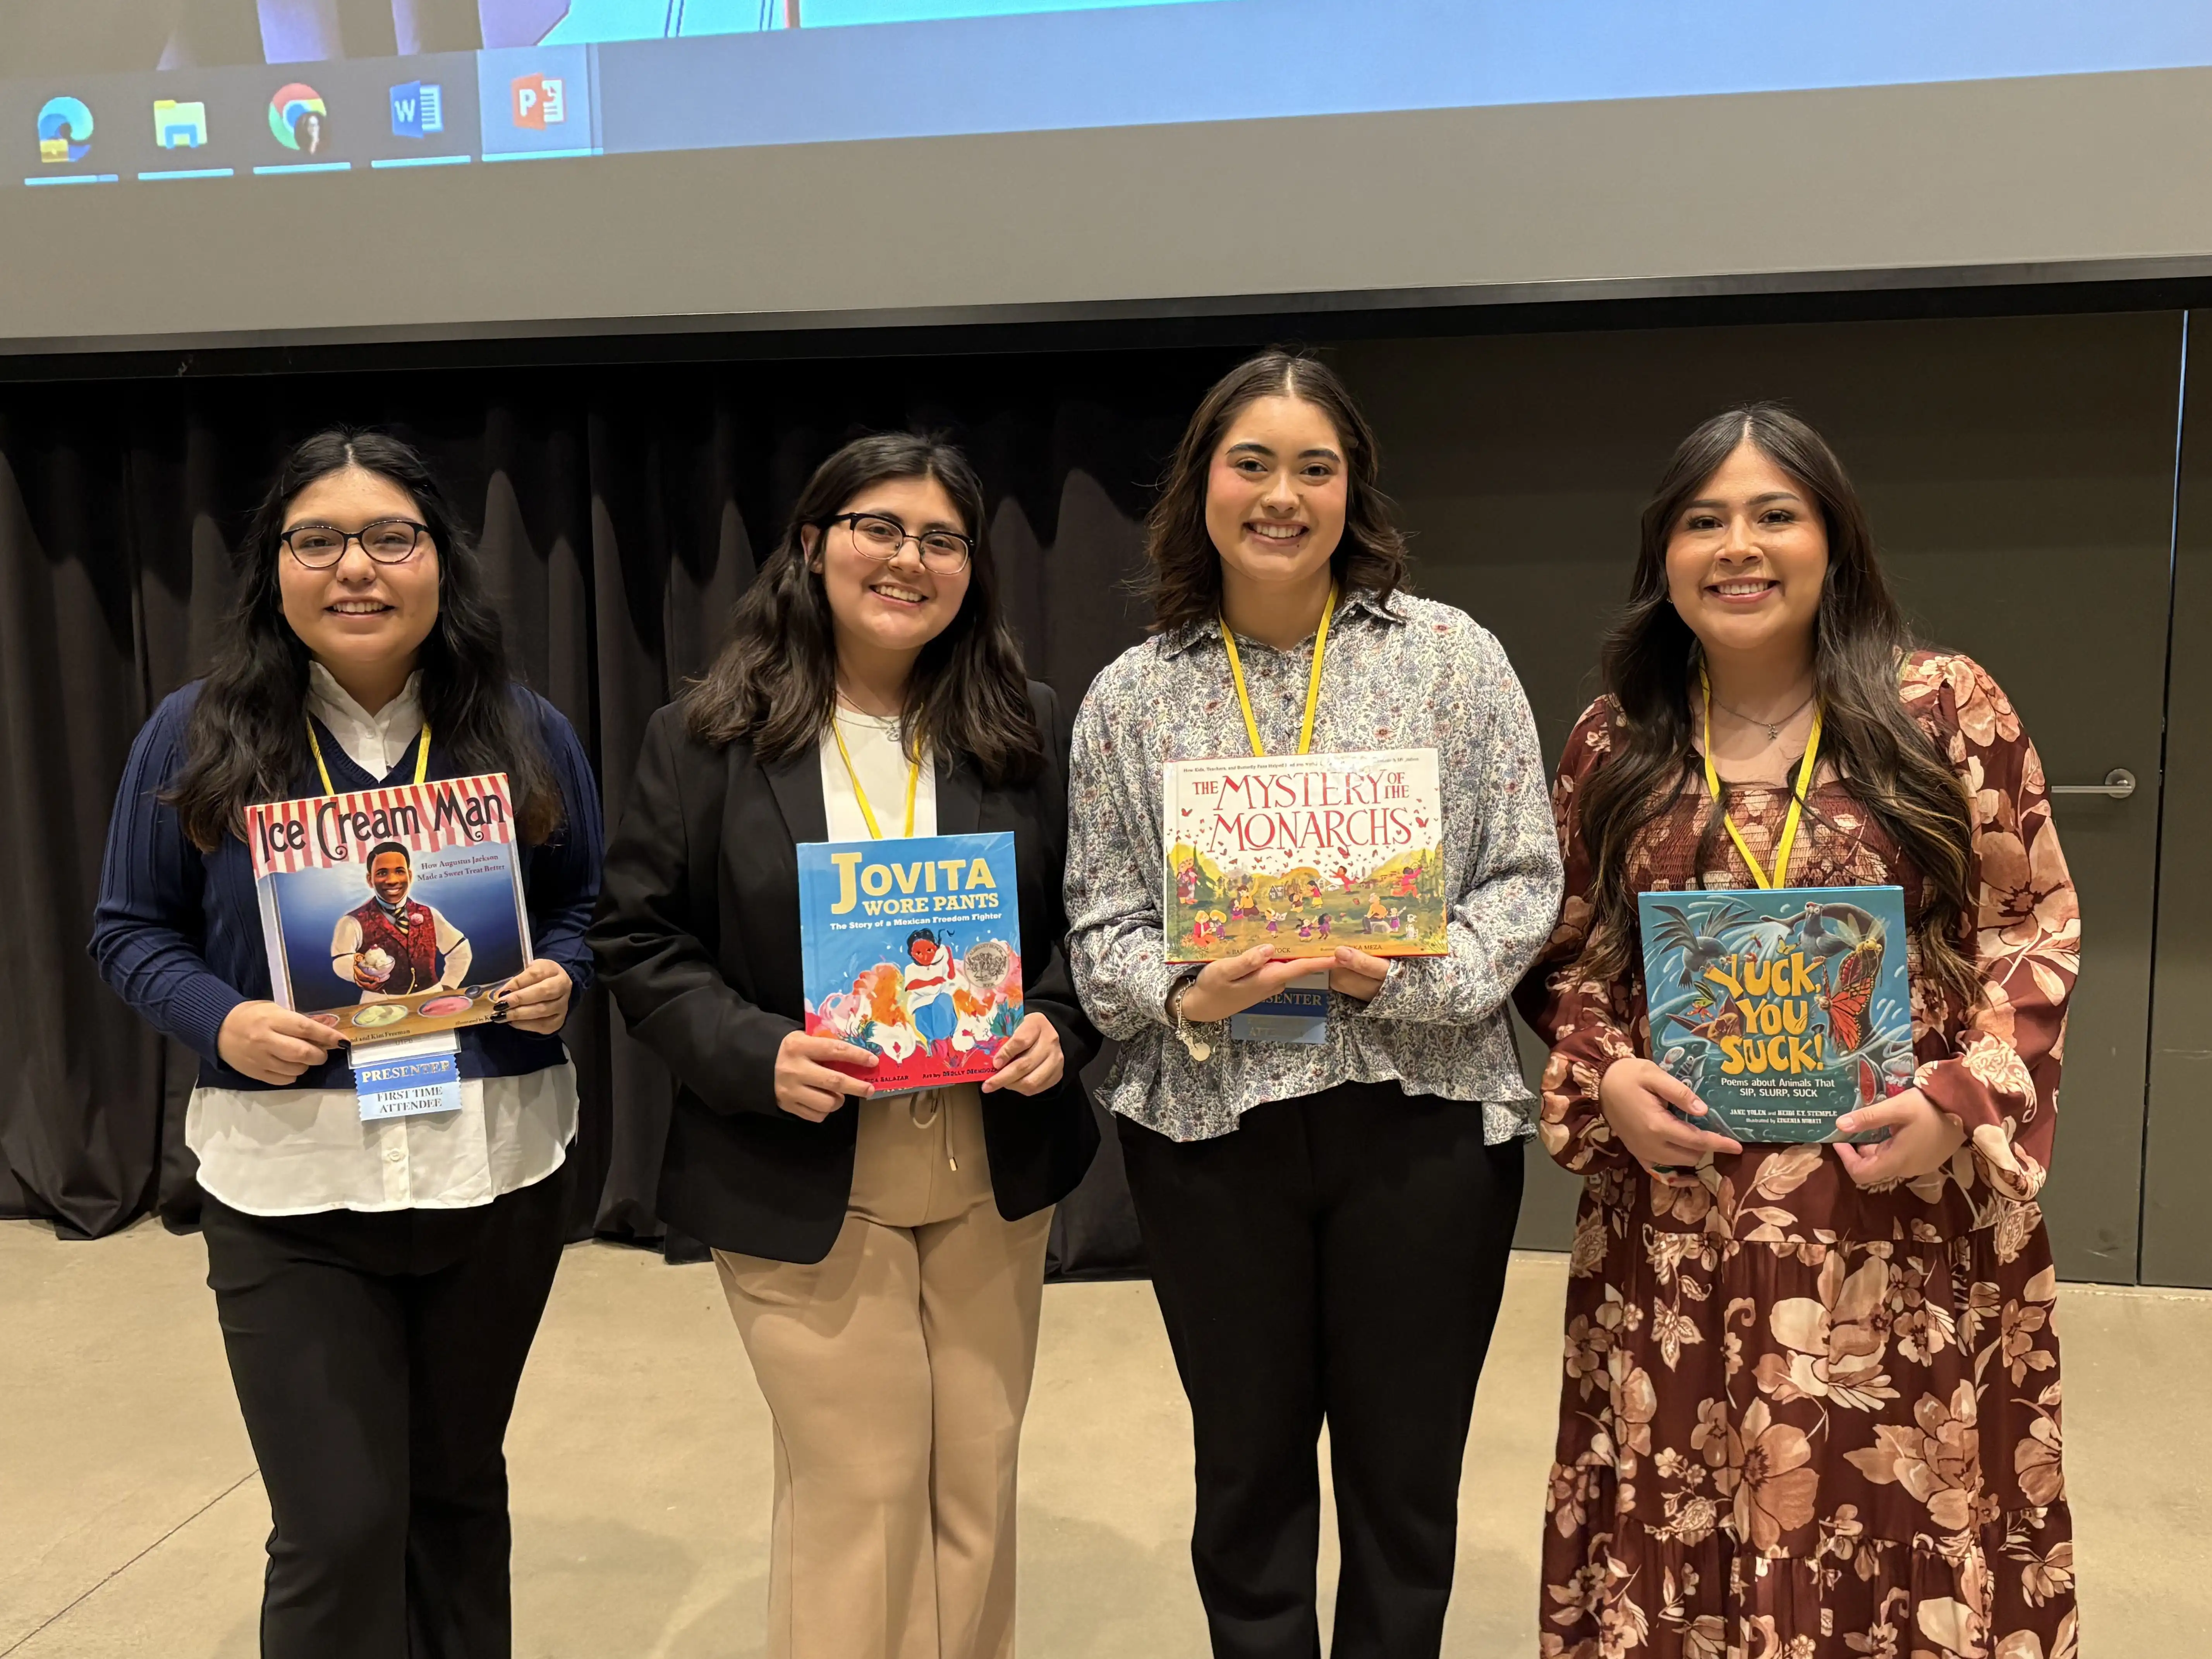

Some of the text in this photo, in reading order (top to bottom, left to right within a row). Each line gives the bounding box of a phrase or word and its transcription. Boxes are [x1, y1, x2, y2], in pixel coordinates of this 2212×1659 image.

[394, 99, 415, 122] W
[519, 88, 536, 117] P
[1192, 769, 1410, 810] THE MYSTERY OF THE
[258, 786, 504, 863] Ice Cream Man
[1207, 807, 1411, 853] MONARCHS
[439, 859, 471, 868] Augustus
[472, 855, 498, 864] Jackson
[417, 873, 437, 881] Made
[831, 852, 996, 914] JOVITA
[862, 893, 999, 915] WORE PANTS
[849, 921, 872, 930] Story
[932, 914, 969, 923] Freedom
[972, 912, 1002, 921] Fighter
[1703, 952, 1823, 999] YUCK,
[1735, 998, 1808, 1035] YOU
[1720, 1033, 1824, 1075] SUCK!
[362, 1060, 450, 1083] PRESENTER
[1721, 1078, 1835, 1087] Poems about Animals That
[378, 1086, 443, 1103] FIRST TIME
[1740, 1088, 1818, 1097] SIP, SLURP, SUCK
[380, 1098, 442, 1114] ATTENDEE
